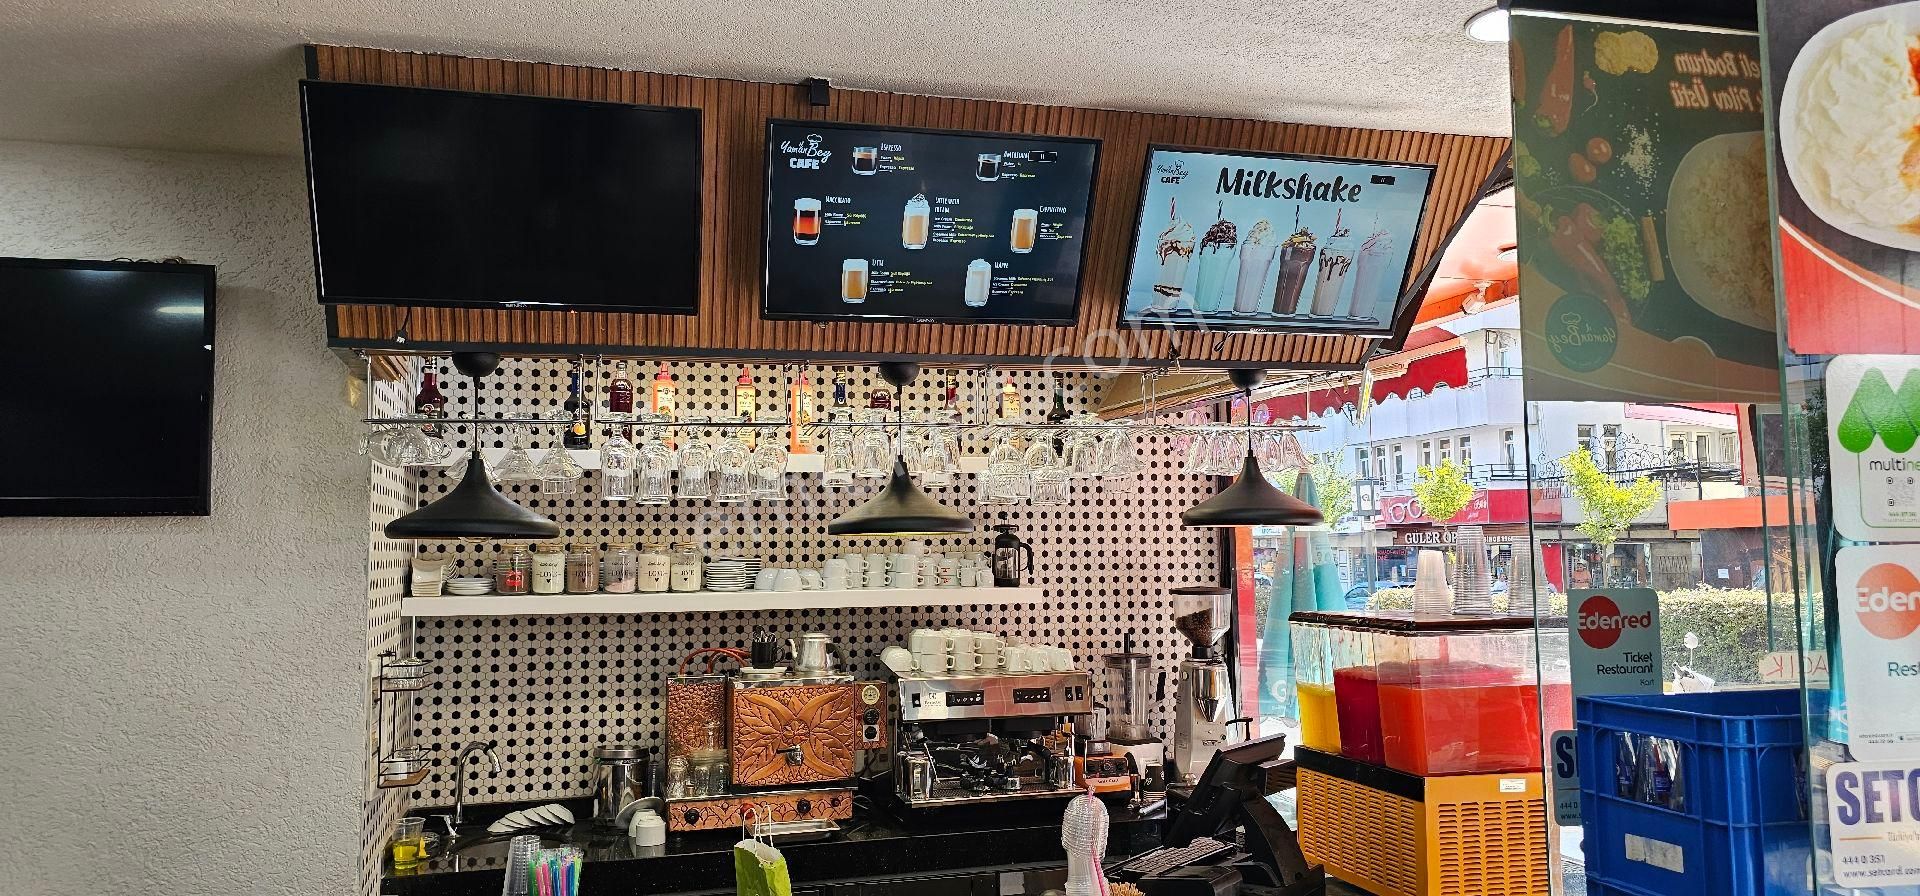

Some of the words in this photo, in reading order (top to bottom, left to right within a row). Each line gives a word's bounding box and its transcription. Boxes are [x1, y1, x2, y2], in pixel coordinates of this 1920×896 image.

[806, 142, 832, 163] Bey
[789, 158, 820, 170] CAFE
[1160, 176, 1181, 184] CAFE
[1215, 167, 1362, 203] Milkshake
[1404, 531, 1441, 545] GÜLER
[1578, 610, 1652, 630] Edenred
[1622, 651, 1653, 663] Ticket
[1596, 662, 1654, 675] Restaurant
[1639, 678, 1655, 687] Kart
[1555, 735, 1579, 779] S
